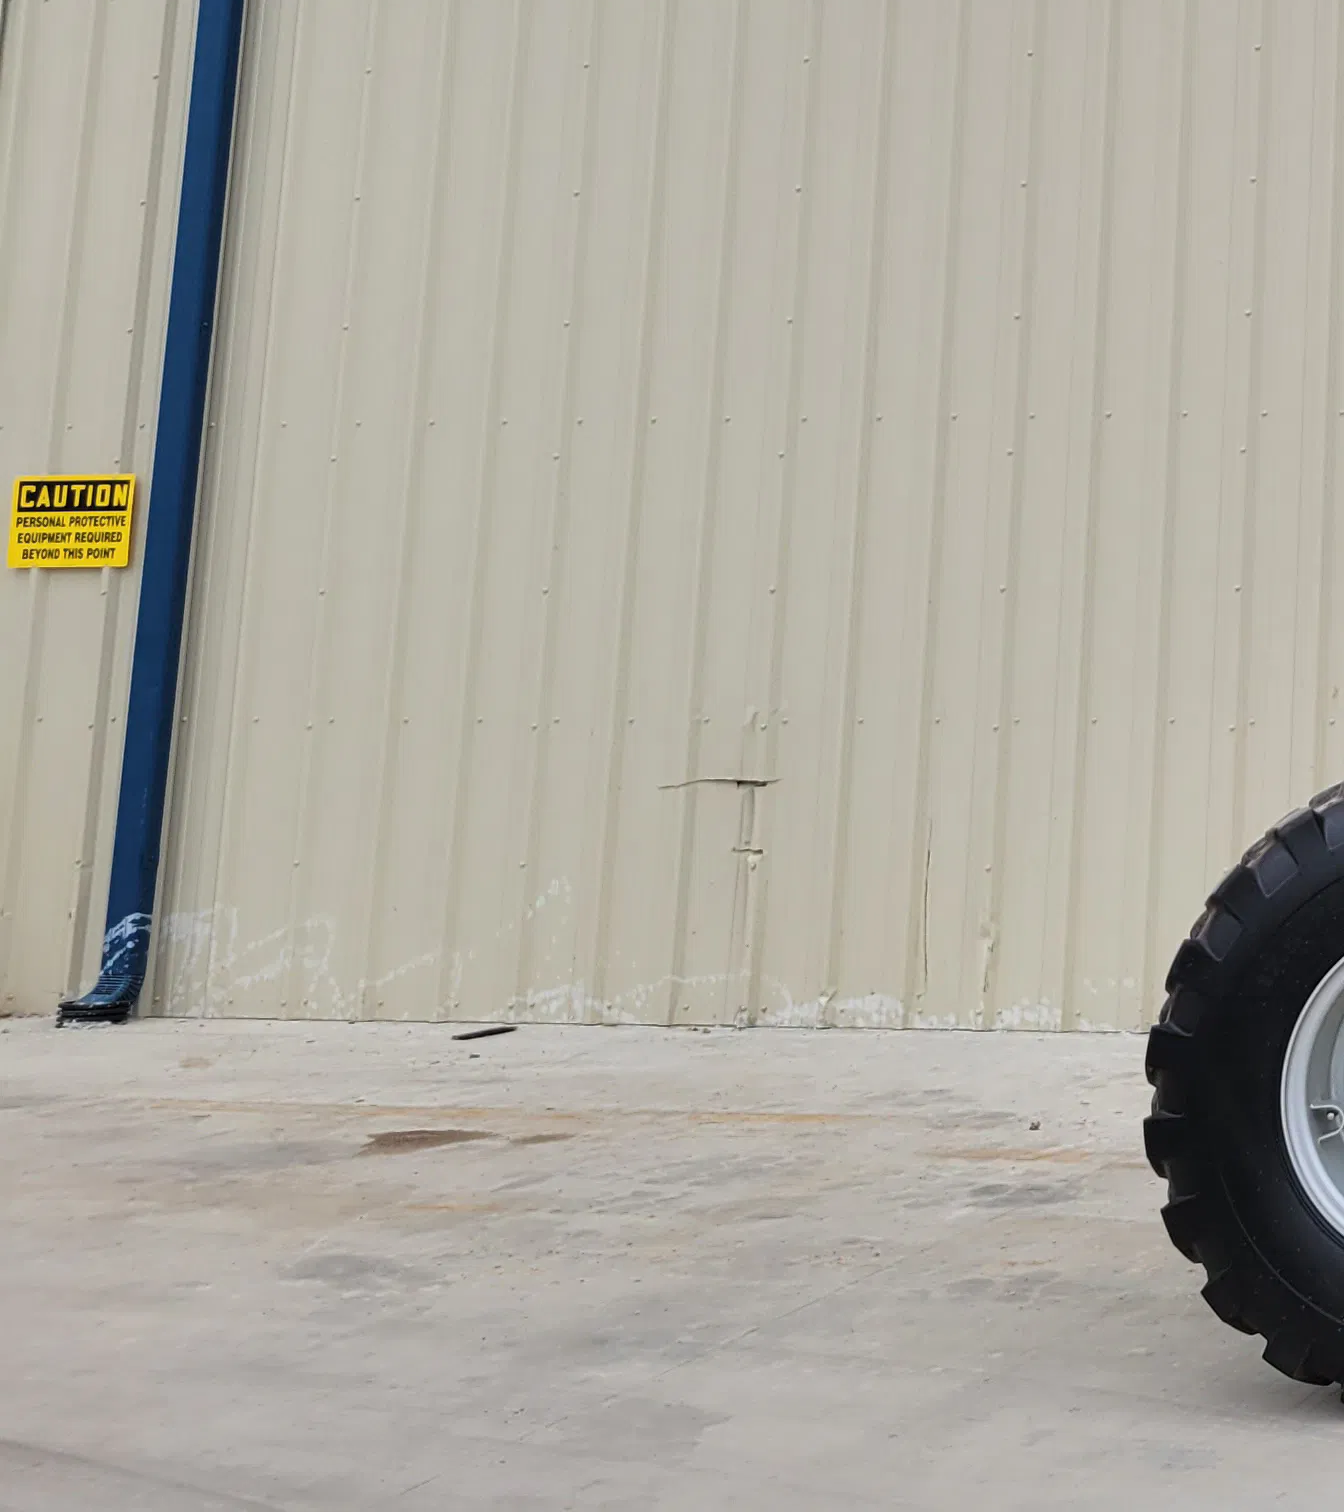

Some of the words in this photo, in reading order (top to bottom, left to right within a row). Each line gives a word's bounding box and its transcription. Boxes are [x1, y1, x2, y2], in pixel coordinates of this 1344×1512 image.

[20, 484, 129, 508] CAUTION
[16, 516, 66, 528] PERSONAL
[69, 515, 127, 527] PROTECTIVE
[17, 532, 72, 544] EQUIPMENT
[74, 532, 122, 543] REQUIRED
[22, 548, 61, 560] BEYOND
[63, 548, 84, 559] THIS
[86, 548, 116, 559] POINT
